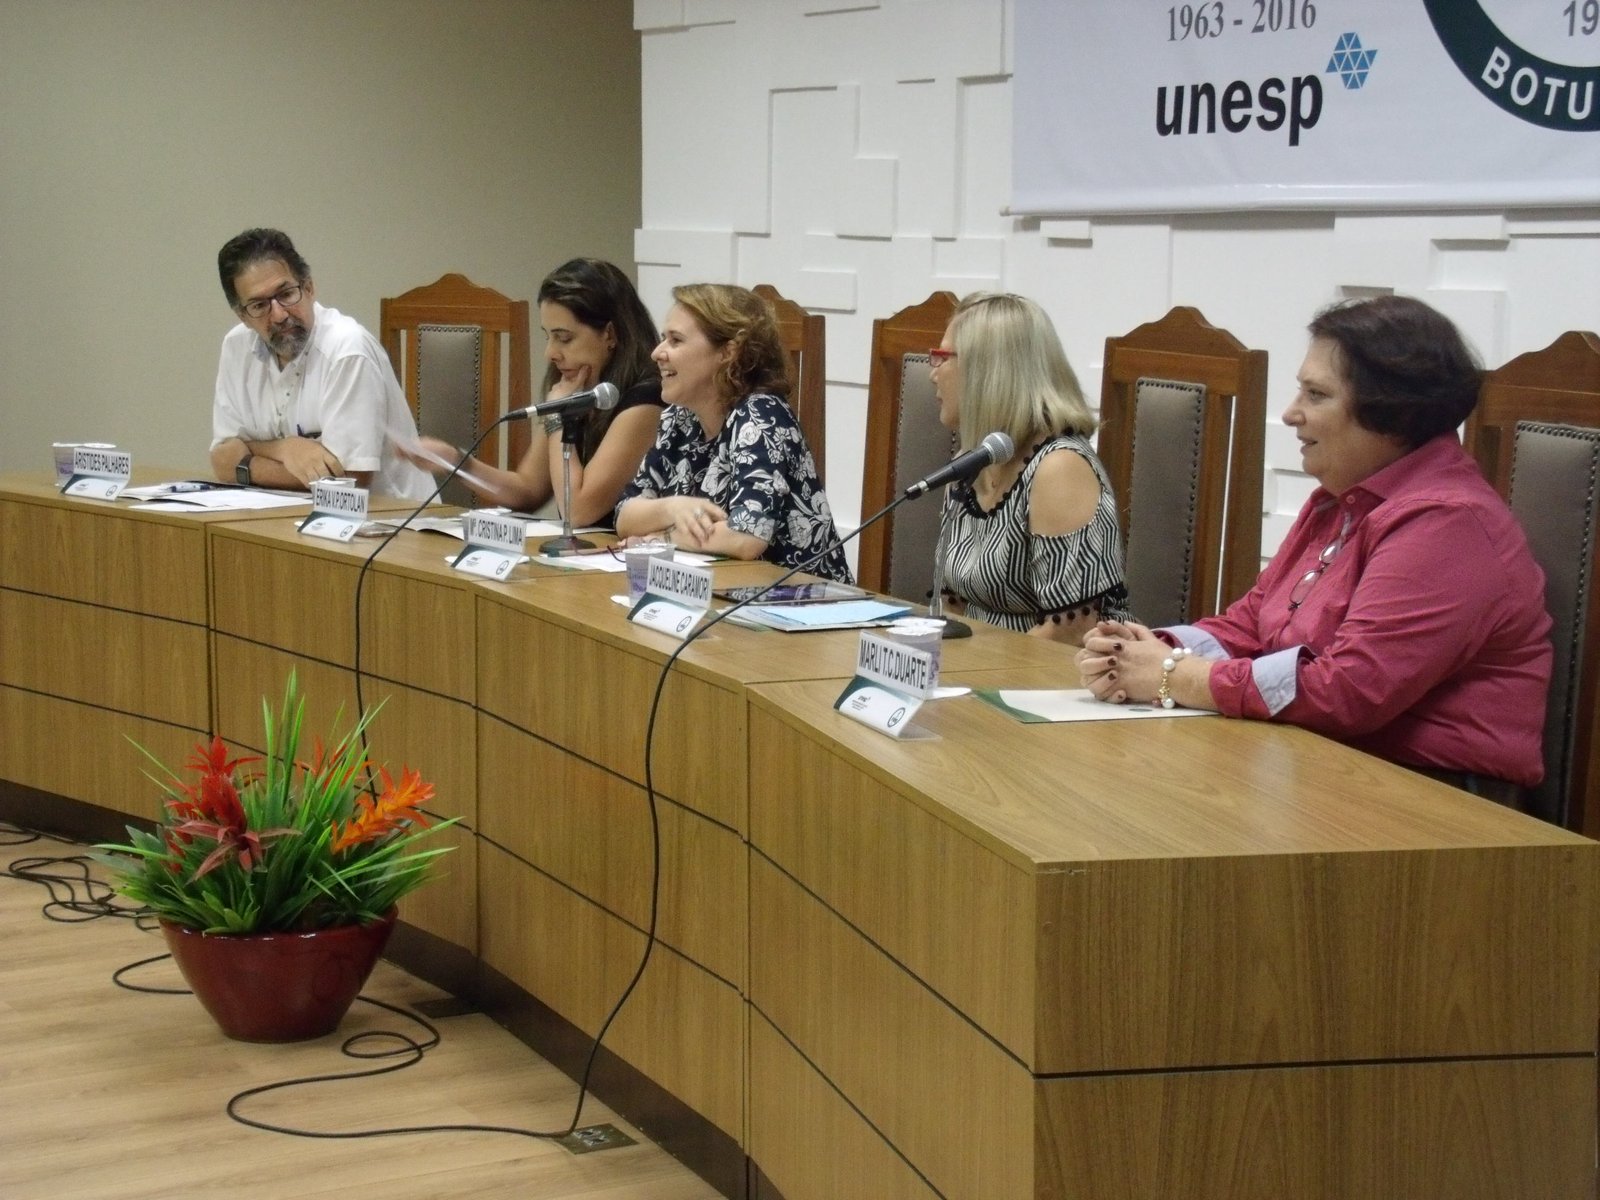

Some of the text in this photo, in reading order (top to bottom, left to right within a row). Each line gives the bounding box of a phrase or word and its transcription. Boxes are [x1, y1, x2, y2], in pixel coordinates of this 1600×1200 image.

[1167, 1, 1224, 41] 1963
[1251, 0, 1317, 33] 2016
[1563, 0, 1599, 37] 19
[1481, 46, 1594, 121] BOTU
[1156, 74, 1323, 147] unesp
[316, 488, 331, 508] ERIKA
[478, 519, 503, 542] CRISTINA
[649, 563, 680, 594] JACQUELINE
[680, 568, 710, 601] CARAMORI
[860, 639, 881, 674] MARLI
